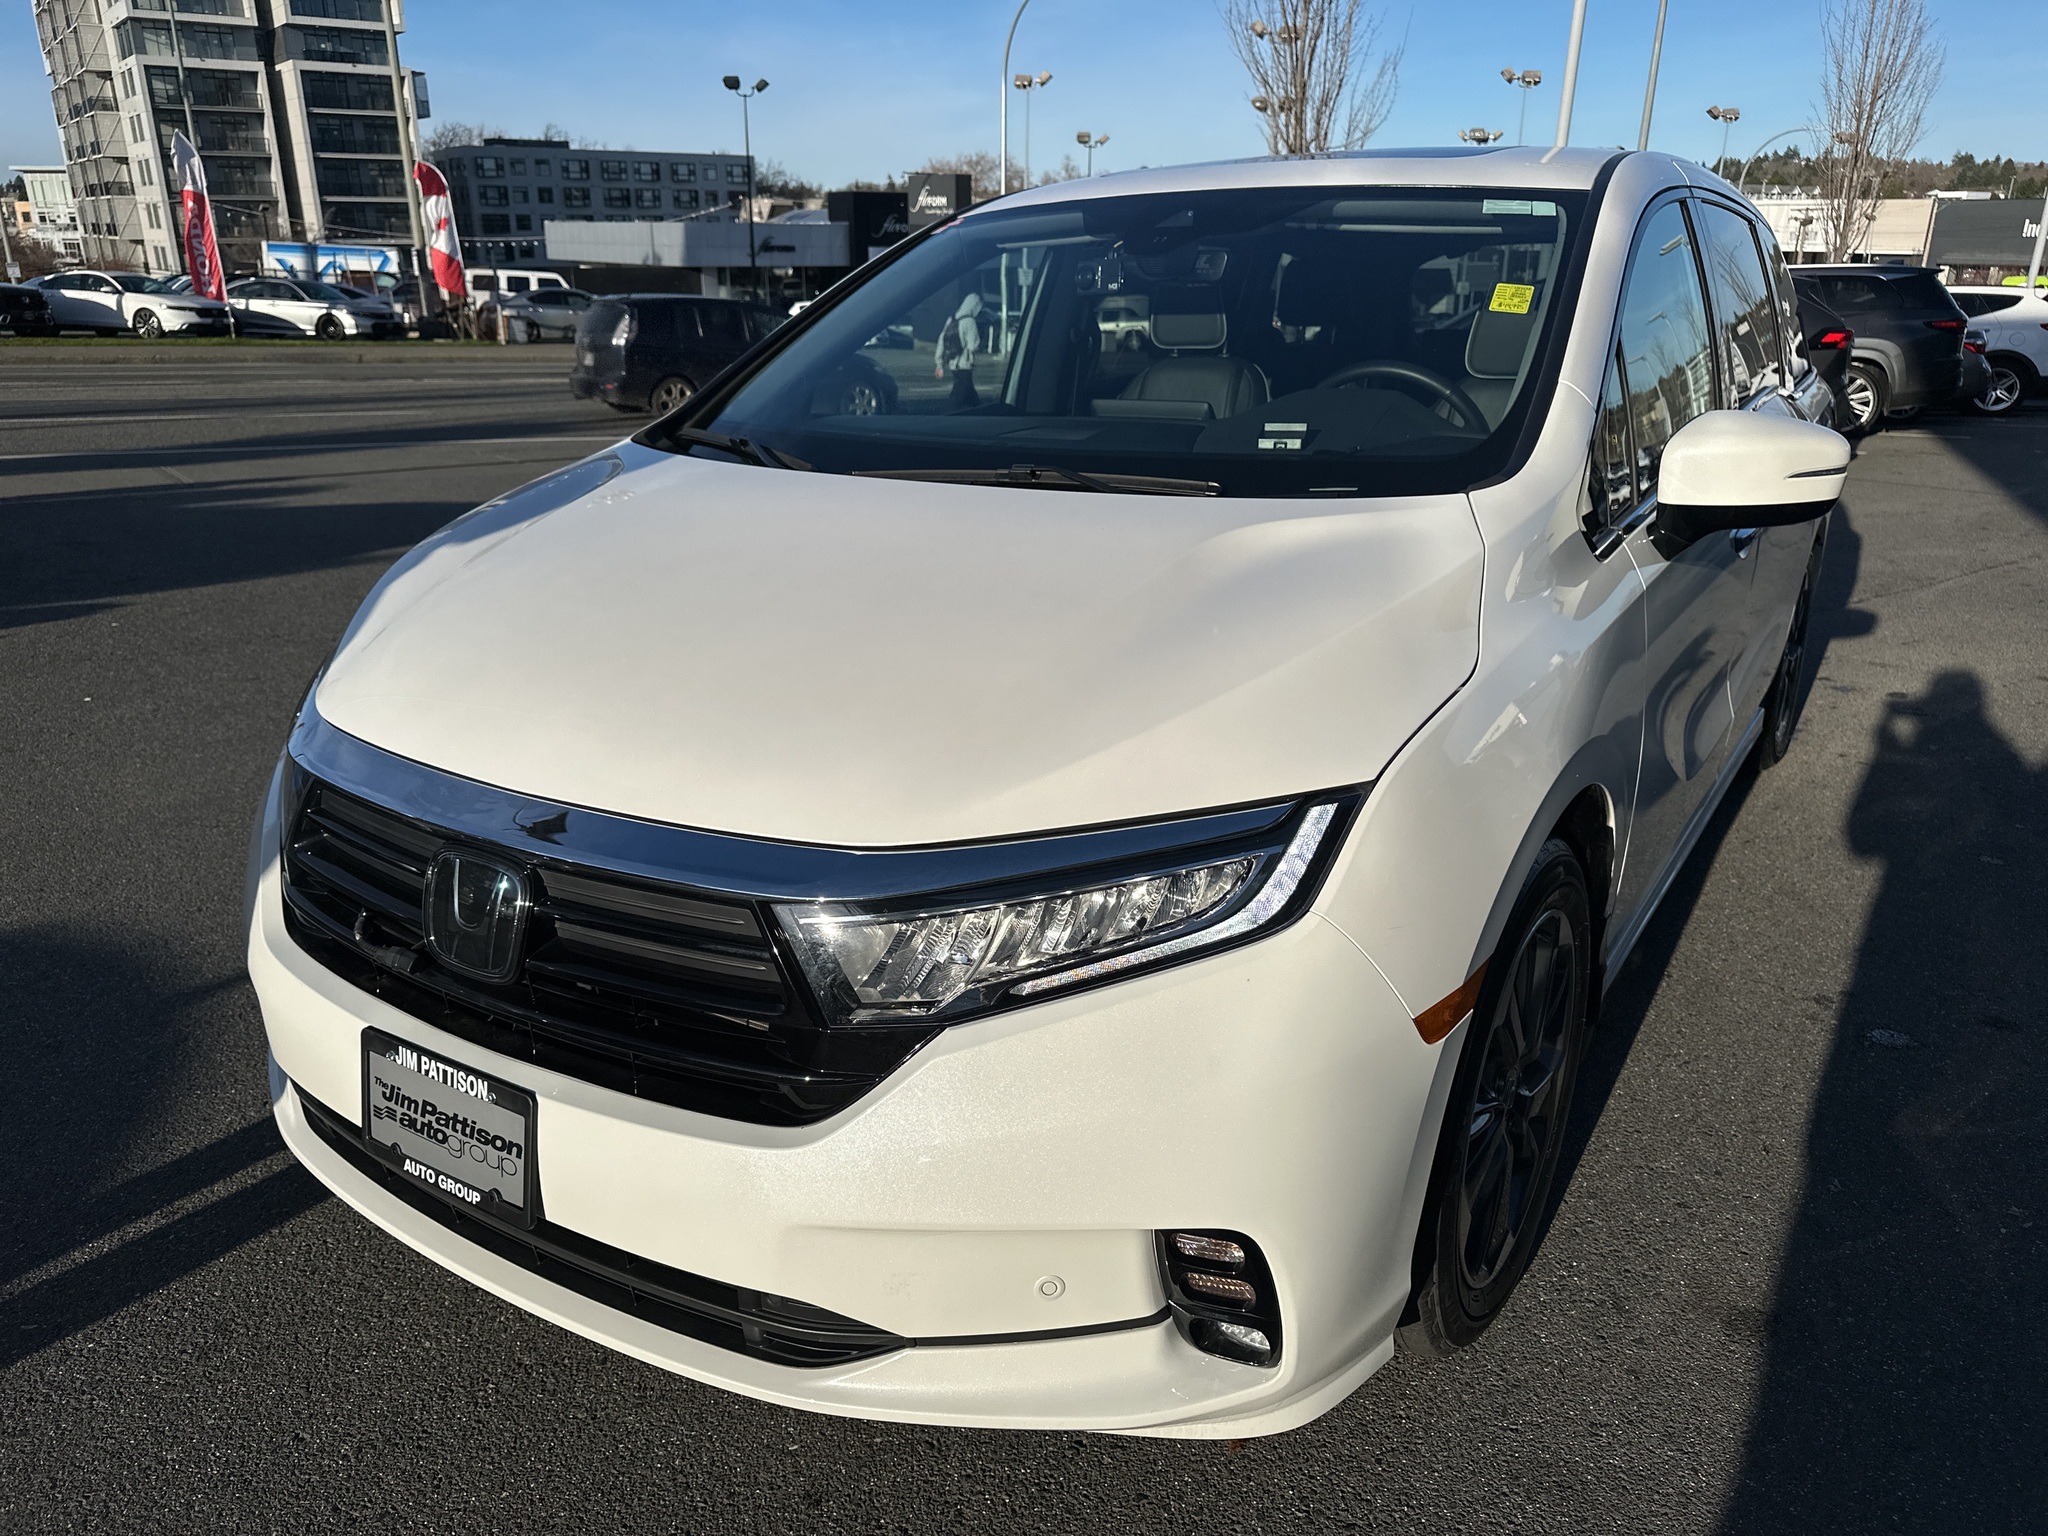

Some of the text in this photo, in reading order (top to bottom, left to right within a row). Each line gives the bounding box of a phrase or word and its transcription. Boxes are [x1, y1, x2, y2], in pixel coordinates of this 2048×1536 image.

[374, 1076, 389, 1091] The
[395, 1046, 489, 1102] JIM PATTISON
[403, 1158, 481, 1205] AUTO GROUP
